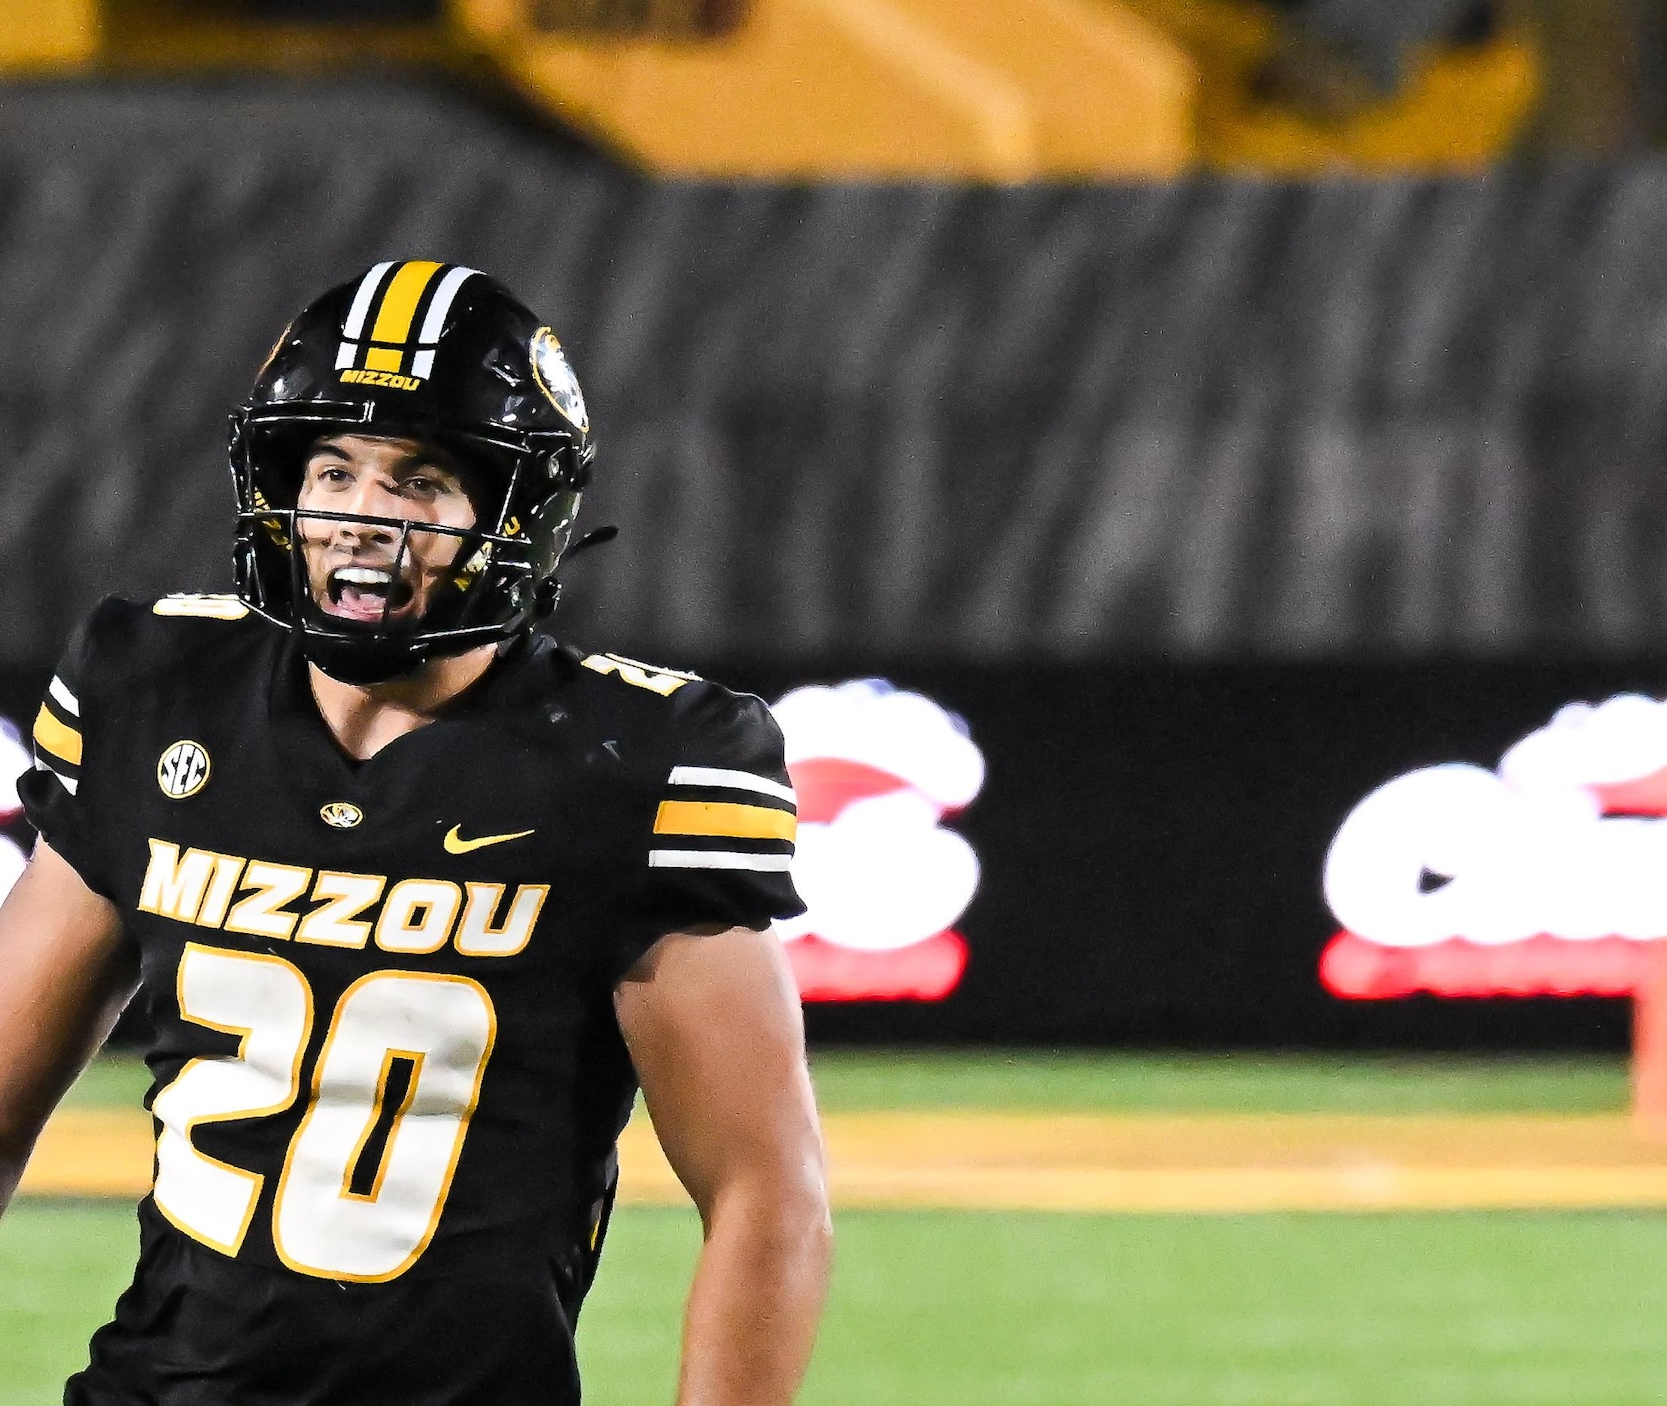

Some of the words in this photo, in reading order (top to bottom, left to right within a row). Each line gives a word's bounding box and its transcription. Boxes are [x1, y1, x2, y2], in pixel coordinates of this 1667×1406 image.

[340, 370, 420, 391] MIZZOU
[160, 743, 208, 796] SEC
[138, 837, 550, 957] MIZZOU
[153, 942, 498, 1283] 20
